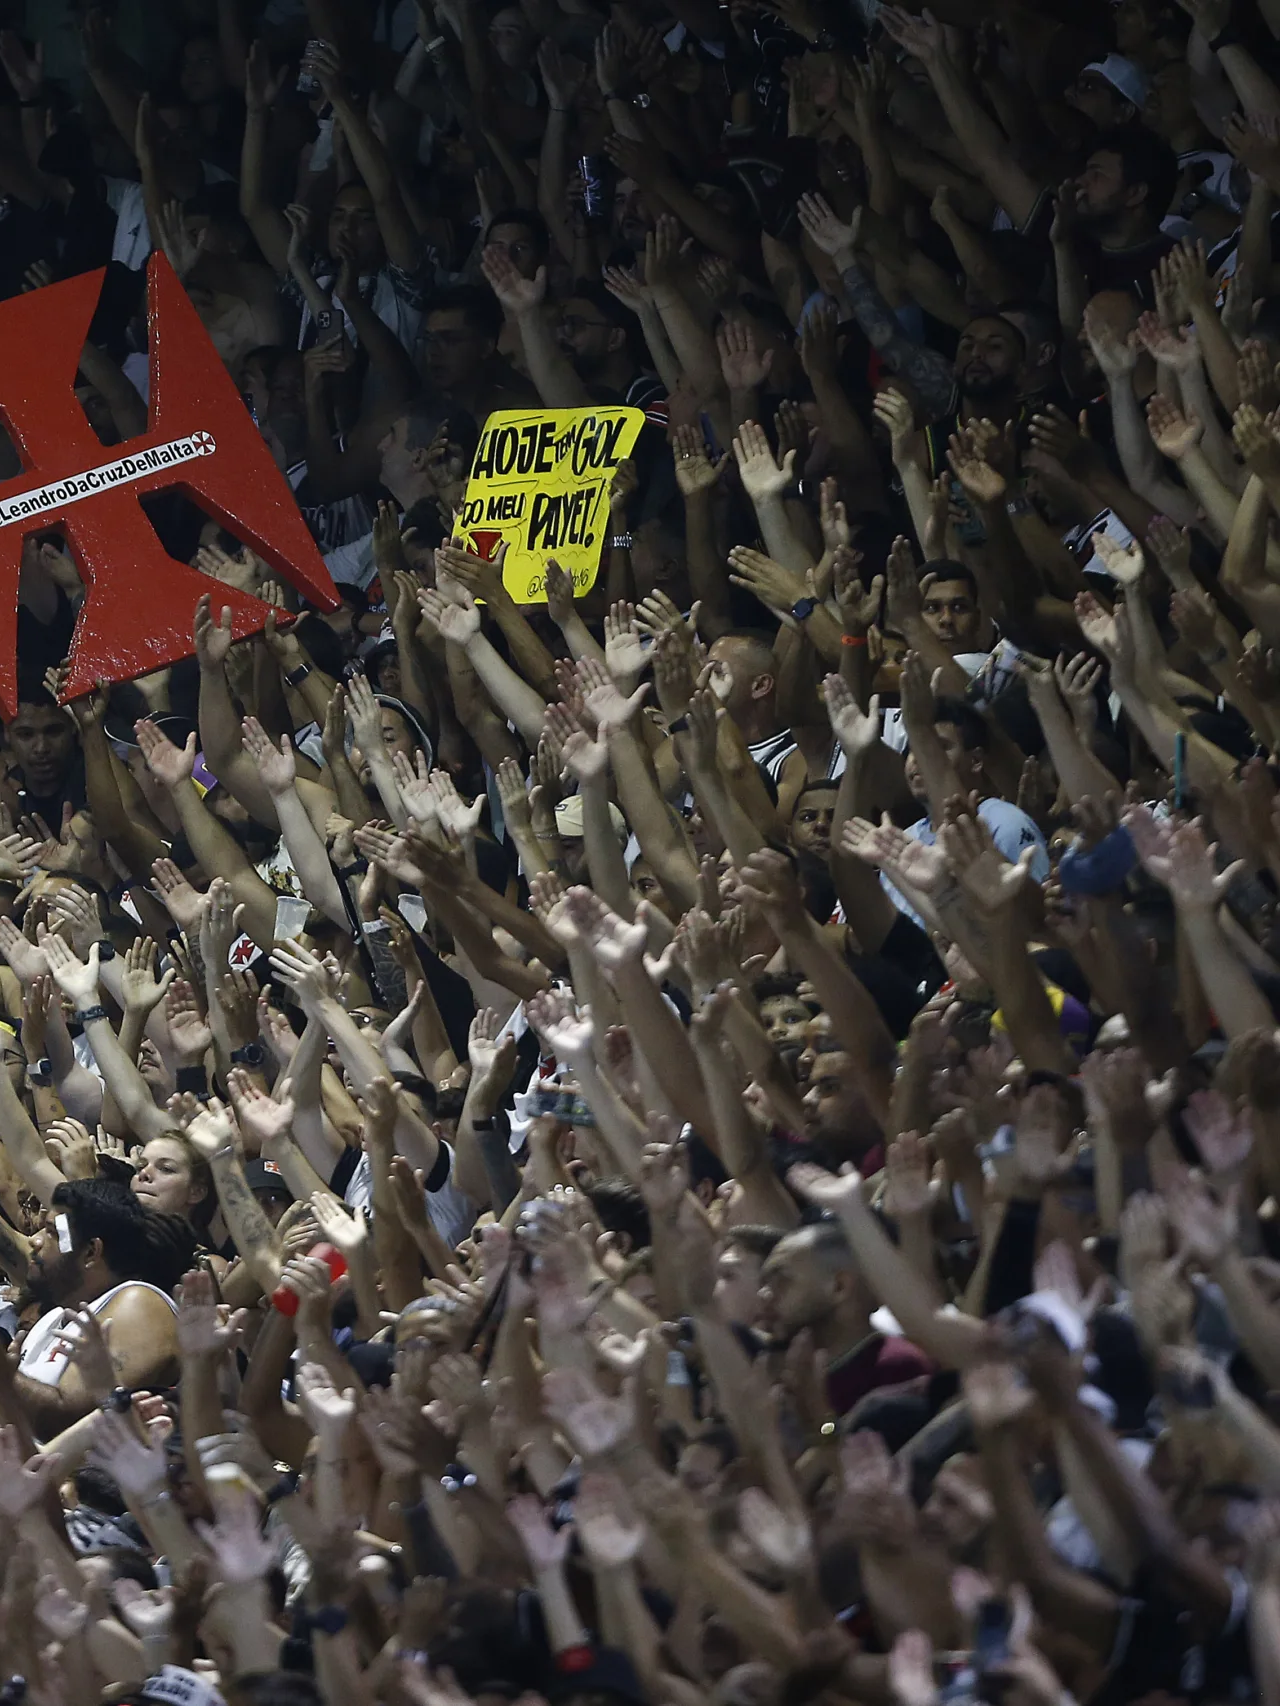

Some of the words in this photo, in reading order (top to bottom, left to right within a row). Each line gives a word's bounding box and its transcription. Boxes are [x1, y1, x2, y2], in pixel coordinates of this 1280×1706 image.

[472, 421, 557, 480] HOJE
[571, 416, 628, 476] GOL
[460, 499, 484, 528] DO
[486, 492, 525, 521] MEU
[527, 477, 607, 551] PAYET!
